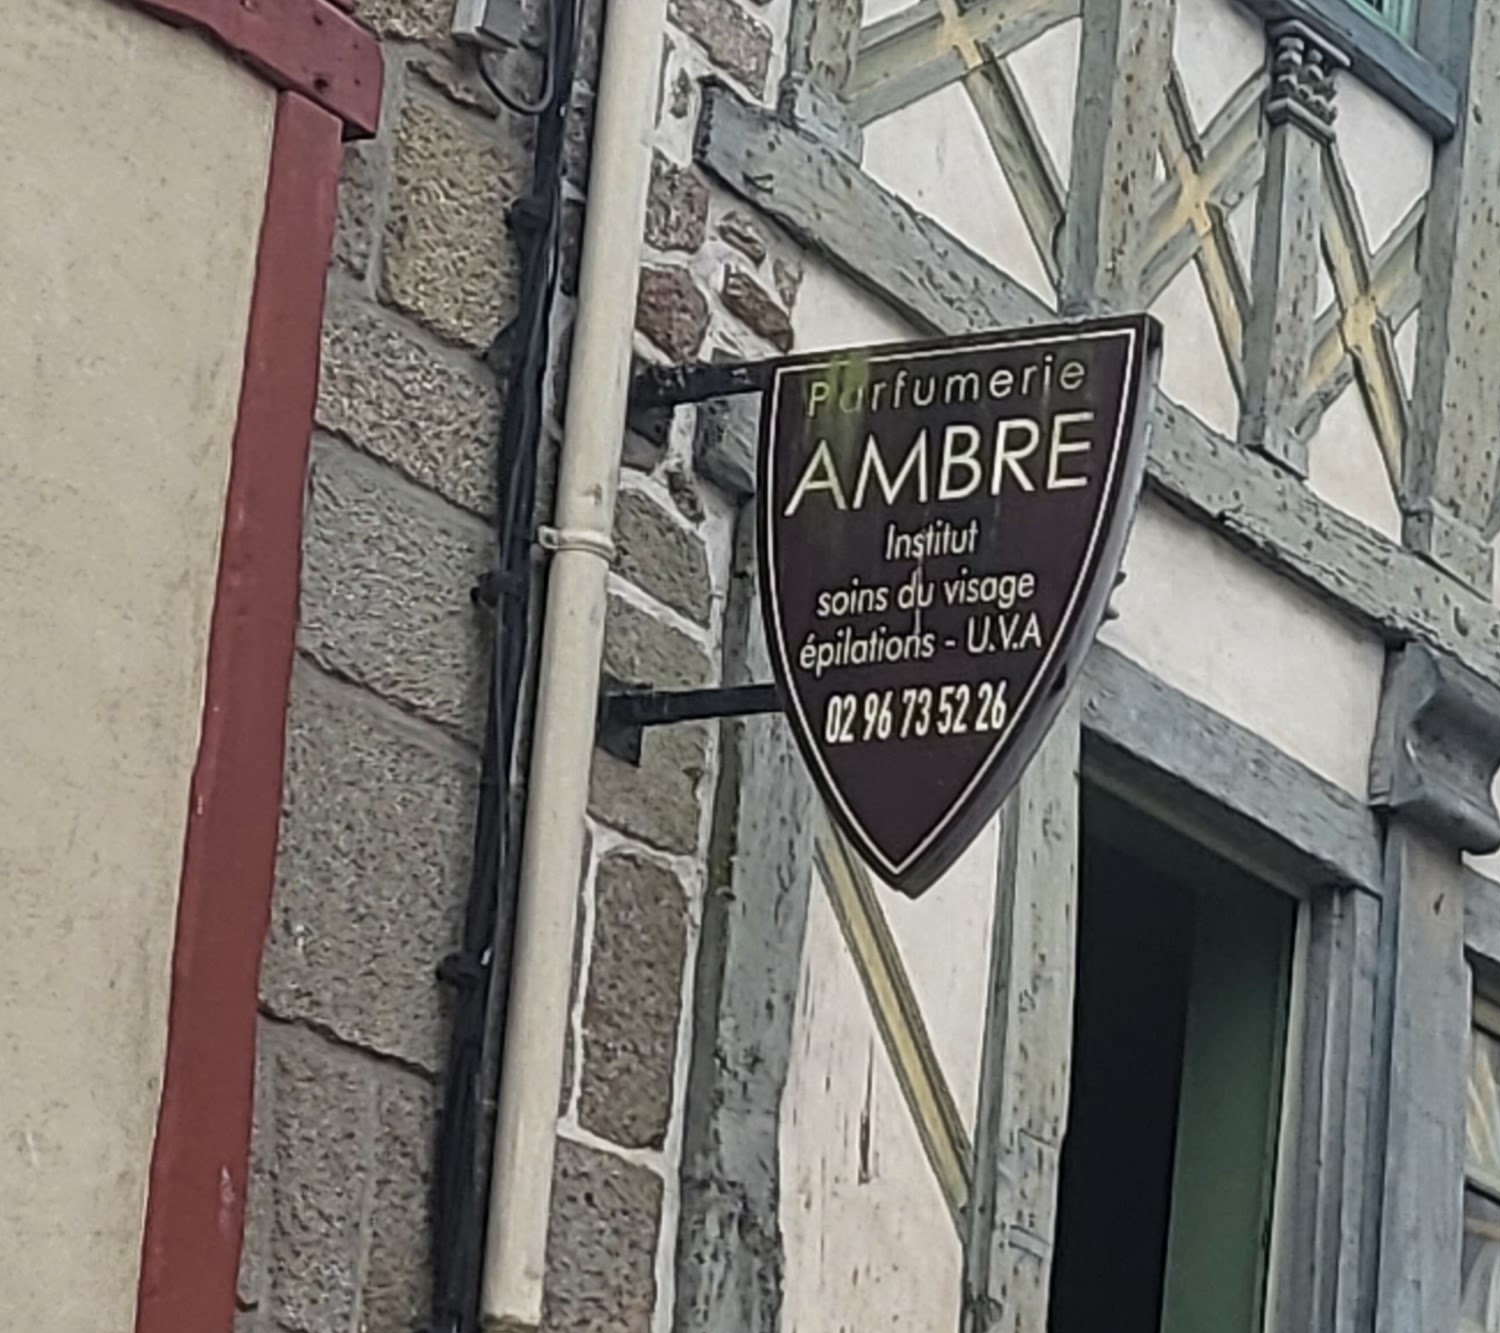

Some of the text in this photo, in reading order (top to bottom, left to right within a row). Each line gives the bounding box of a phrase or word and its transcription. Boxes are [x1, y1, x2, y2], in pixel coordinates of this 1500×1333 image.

[807, 353, 1086, 418] Parfumerie
[783, 411, 1095, 517] AMBRE
[885, 518, 979, 561] Institut
[816, 565, 1036, 618] soins du visage
[799, 625, 936, 678] épilations
[966, 611, 1043, 654] U.V.A
[825, 679, 1007, 744] 02 96 73 52 26
